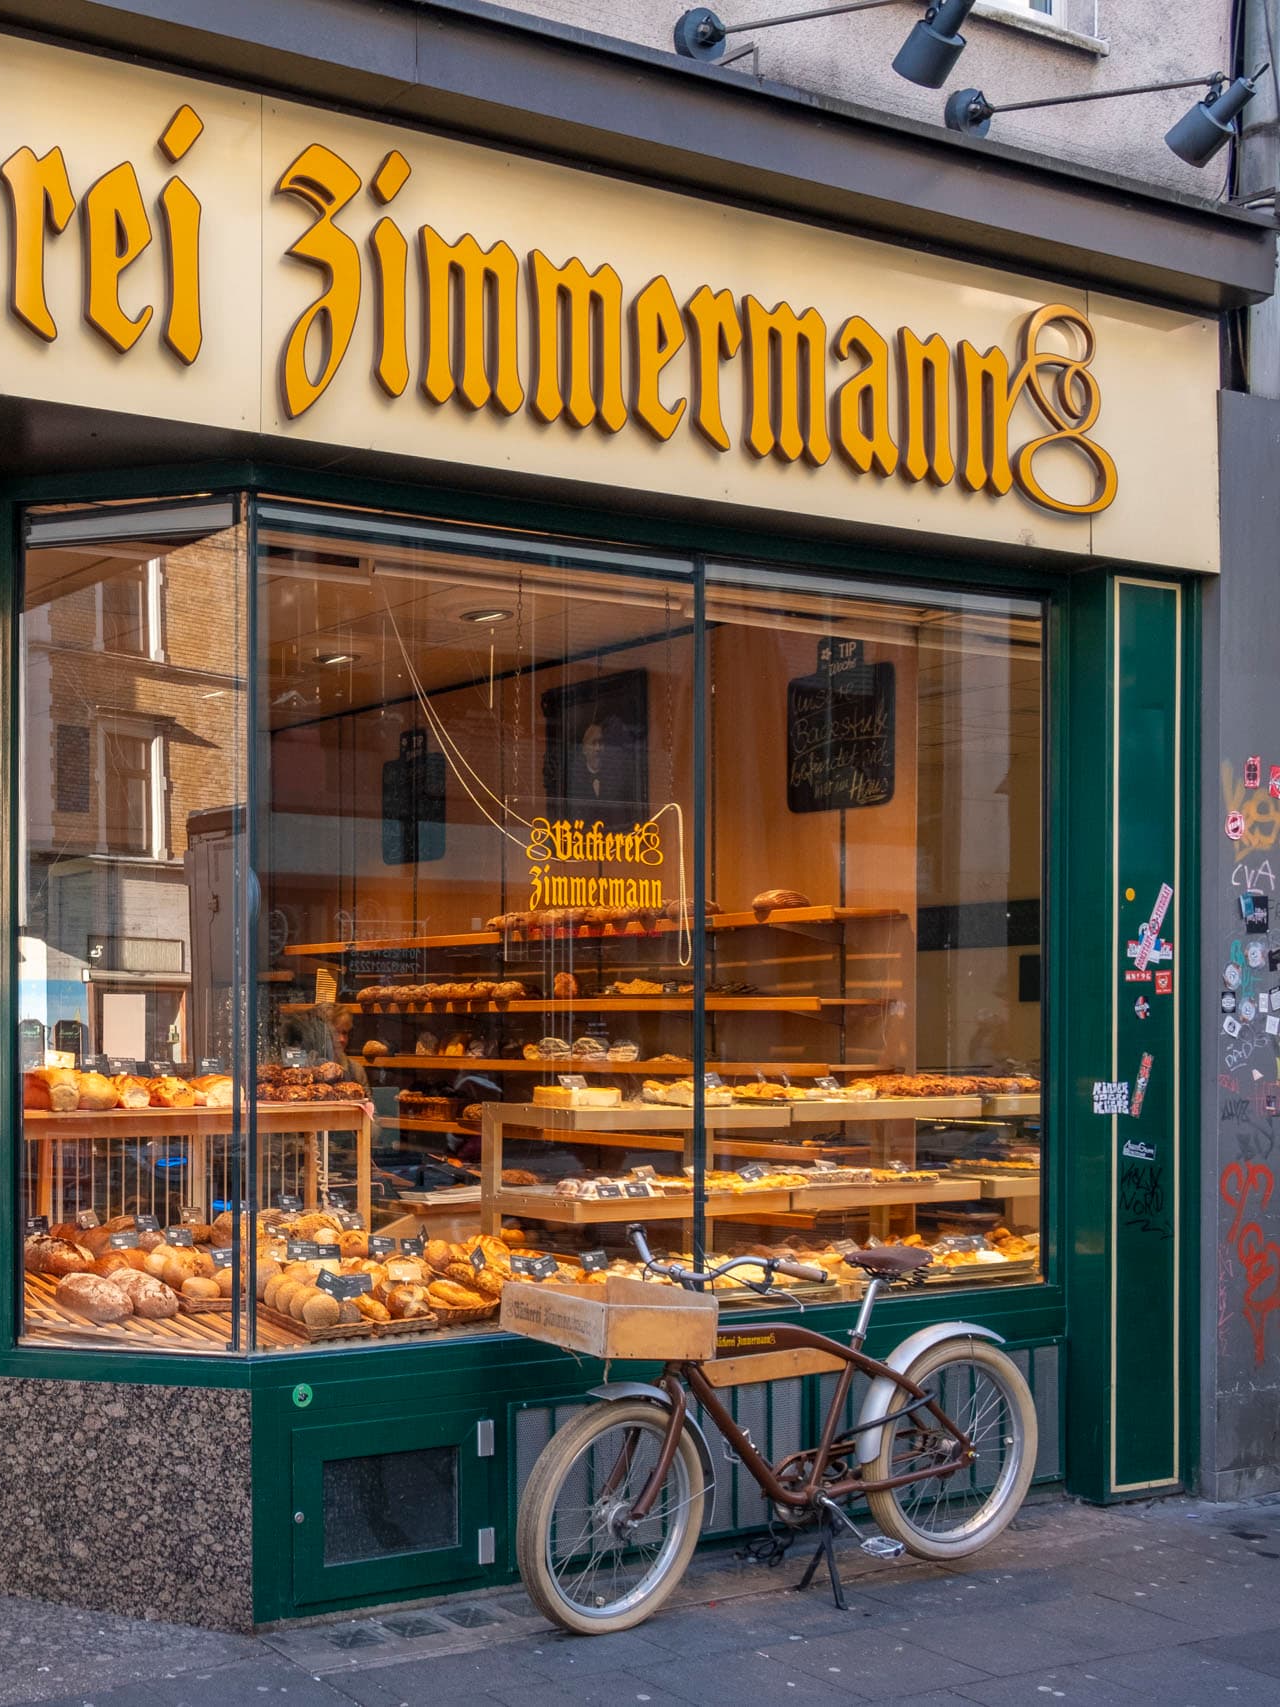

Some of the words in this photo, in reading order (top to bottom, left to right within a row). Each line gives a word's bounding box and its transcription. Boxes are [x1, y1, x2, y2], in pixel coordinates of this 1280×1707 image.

[275, 142, 1117, 515] Zimmermann
[526, 817, 663, 865] Bäckerei
[529, 864, 663, 911] Zimmermann
